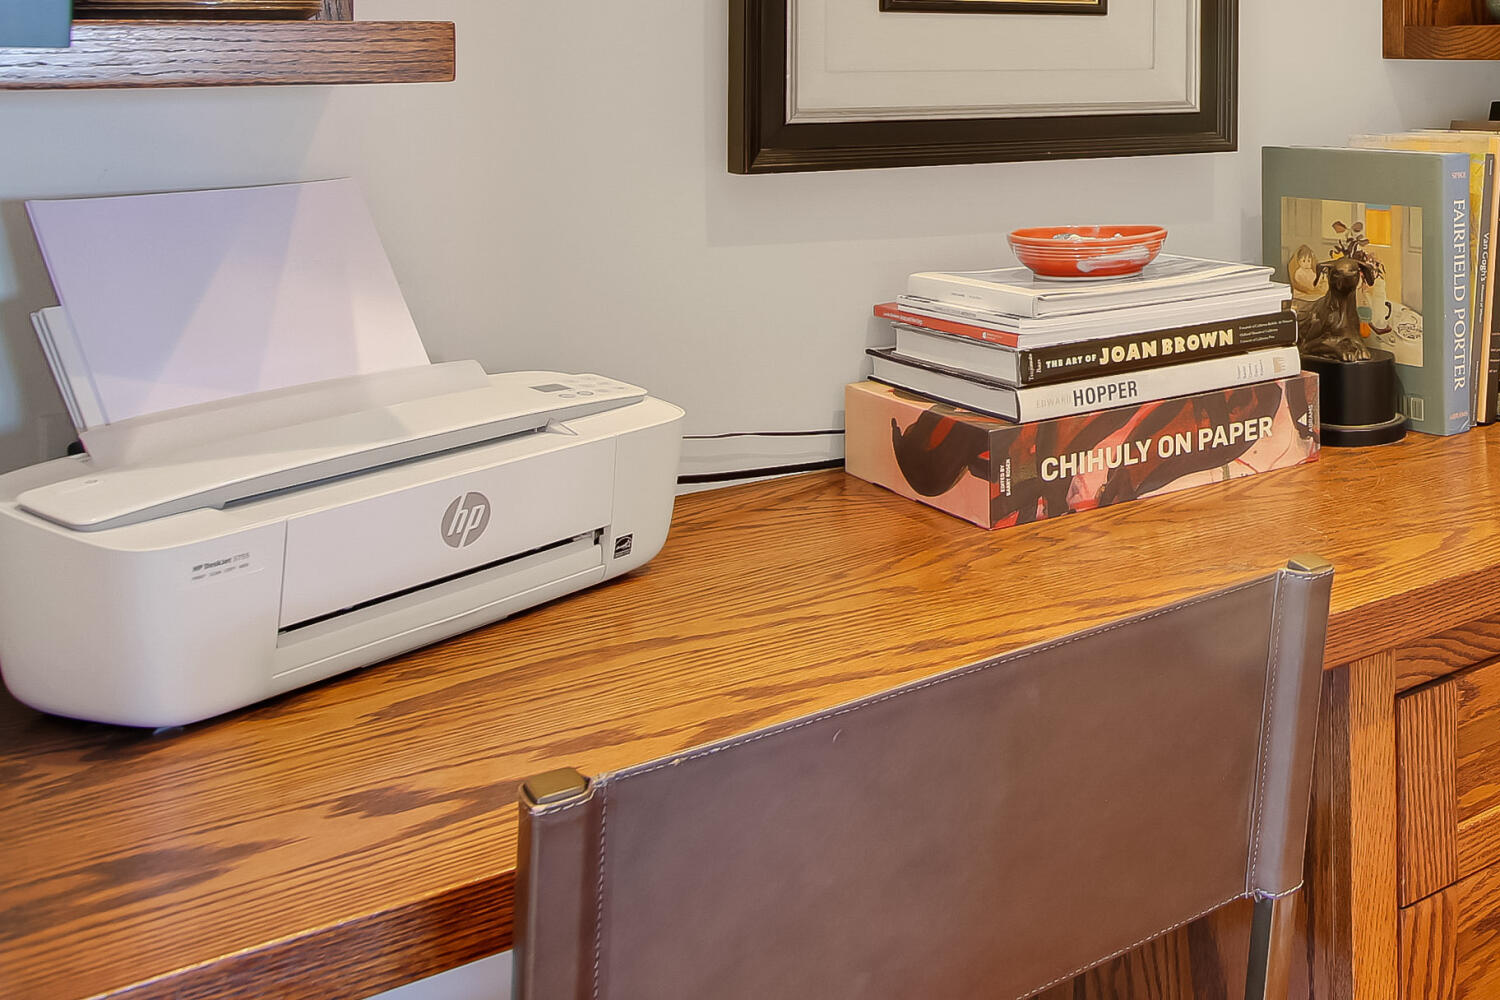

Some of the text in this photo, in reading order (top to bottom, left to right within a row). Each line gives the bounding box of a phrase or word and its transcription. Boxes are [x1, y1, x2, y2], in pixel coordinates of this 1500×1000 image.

[1480, 250, 1489, 283] Gogh's
[1453, 199, 1467, 392] FAIRFIELD PORTER
[1045, 328, 1234, 369] THE ART OF JOAN BROWN
[1073, 380, 1138, 407] HOPPER
[1000, 463, 1006, 472] BY
[1040, 416, 1274, 482] CHIHULY ON PAPER
[445, 492, 488, 548] hp
